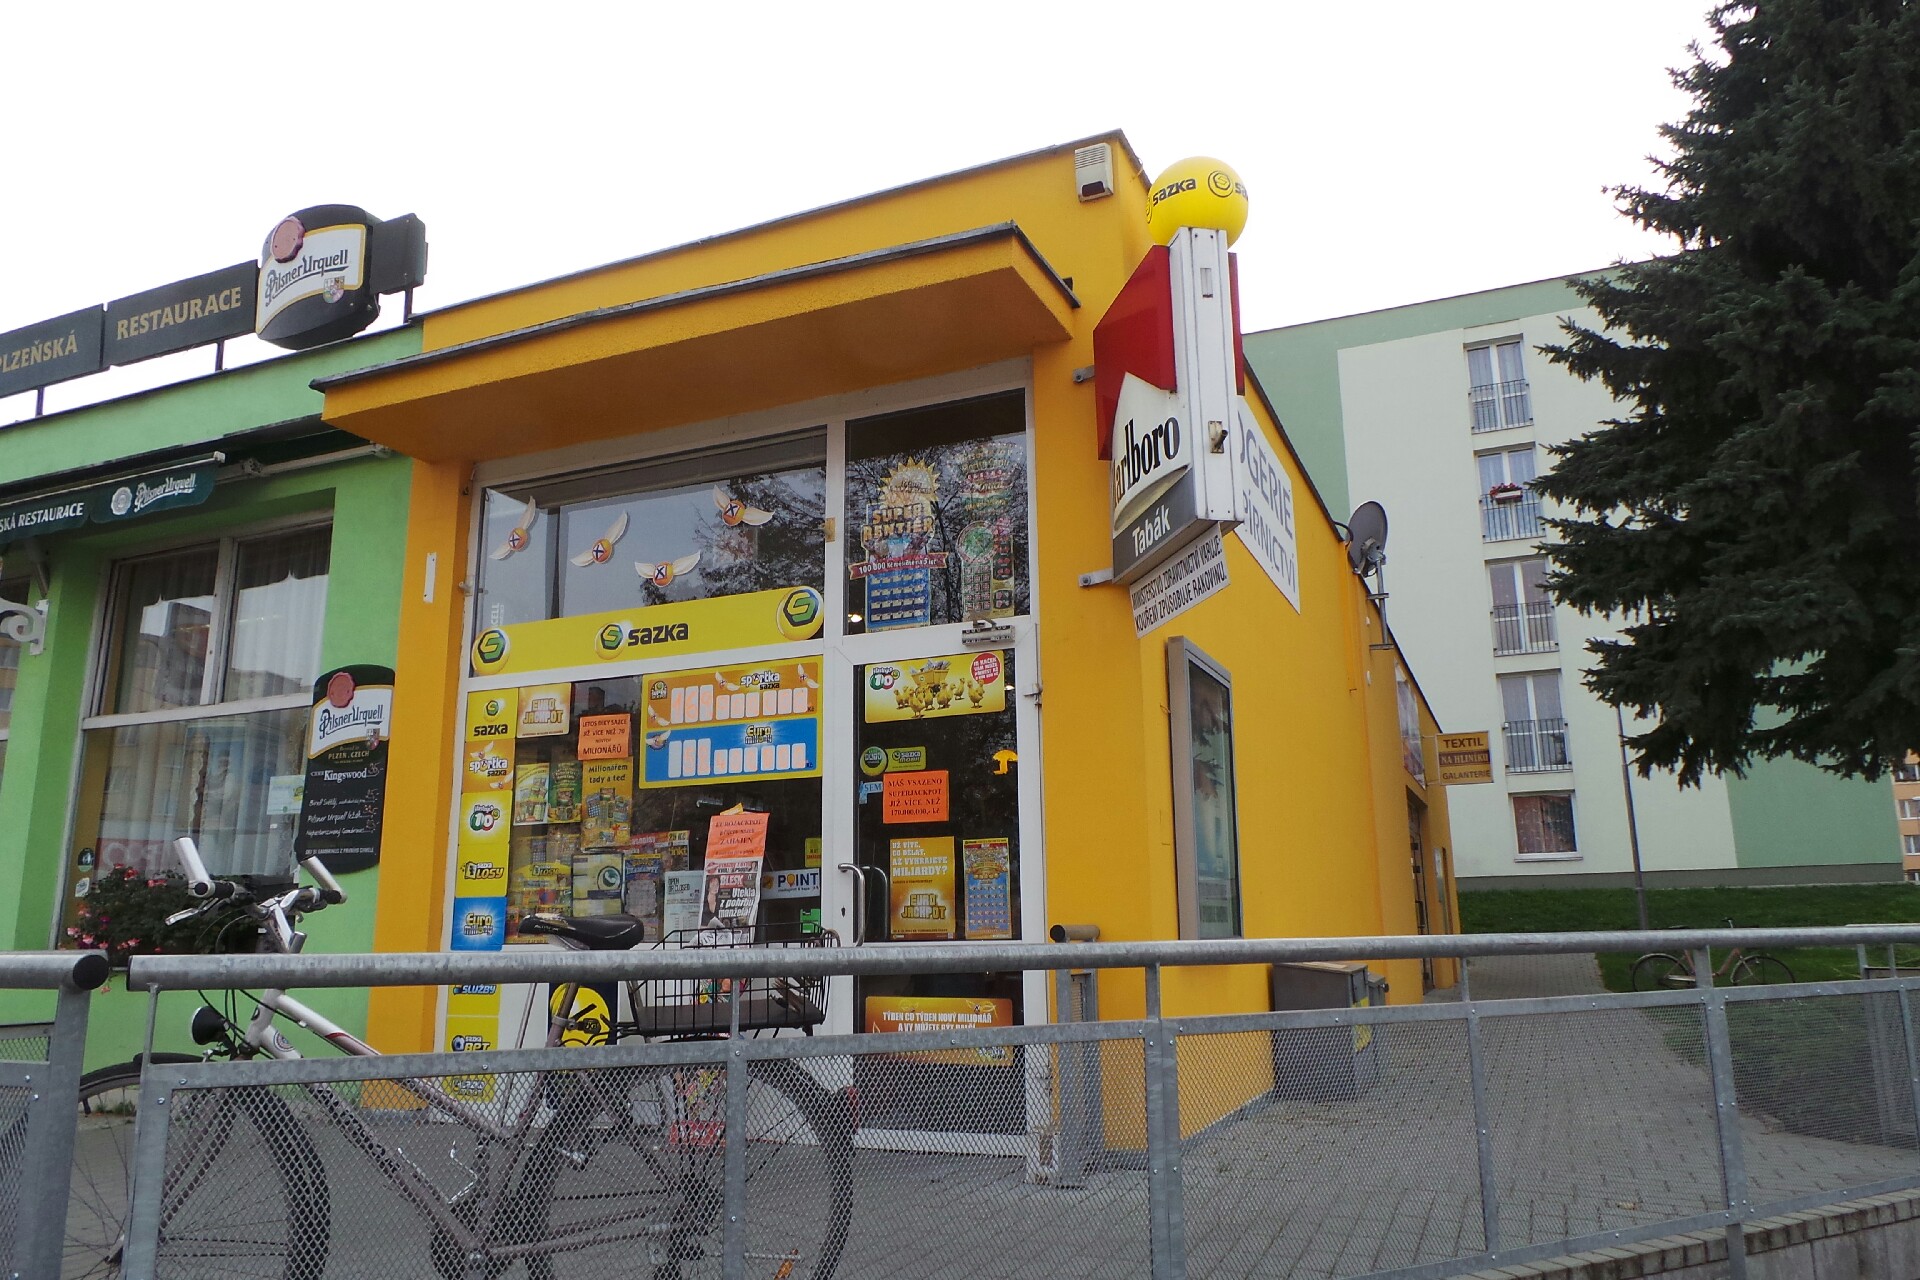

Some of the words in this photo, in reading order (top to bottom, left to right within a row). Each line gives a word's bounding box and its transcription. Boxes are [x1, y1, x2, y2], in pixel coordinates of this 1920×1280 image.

[265, 264, 303, 307] Pilsner
[302, 250, 349, 277] Urquell
[117, 287, 241, 340] RESTAURACE
[18, 502, 85, 527] RESTAURACE
[1132, 504, 1171, 558] Tabák
[319, 708, 352, 739] Pilsner
[352, 704, 383, 727] Urquell
[1443, 737, 1484, 748] TEXTIL
[324, 768, 367, 783] Kingswood
[1442, 770, 1491, 780] GALANTERIE
[888, 788, 941, 797] SUPERJACKPOT
[883, 1010, 904, 1021] TÝDEN
[904, 1011, 914, 1021] CO
[916, 1010, 937, 1022] TÝDEN
[938, 1011, 956, 1022] NOVÝ
